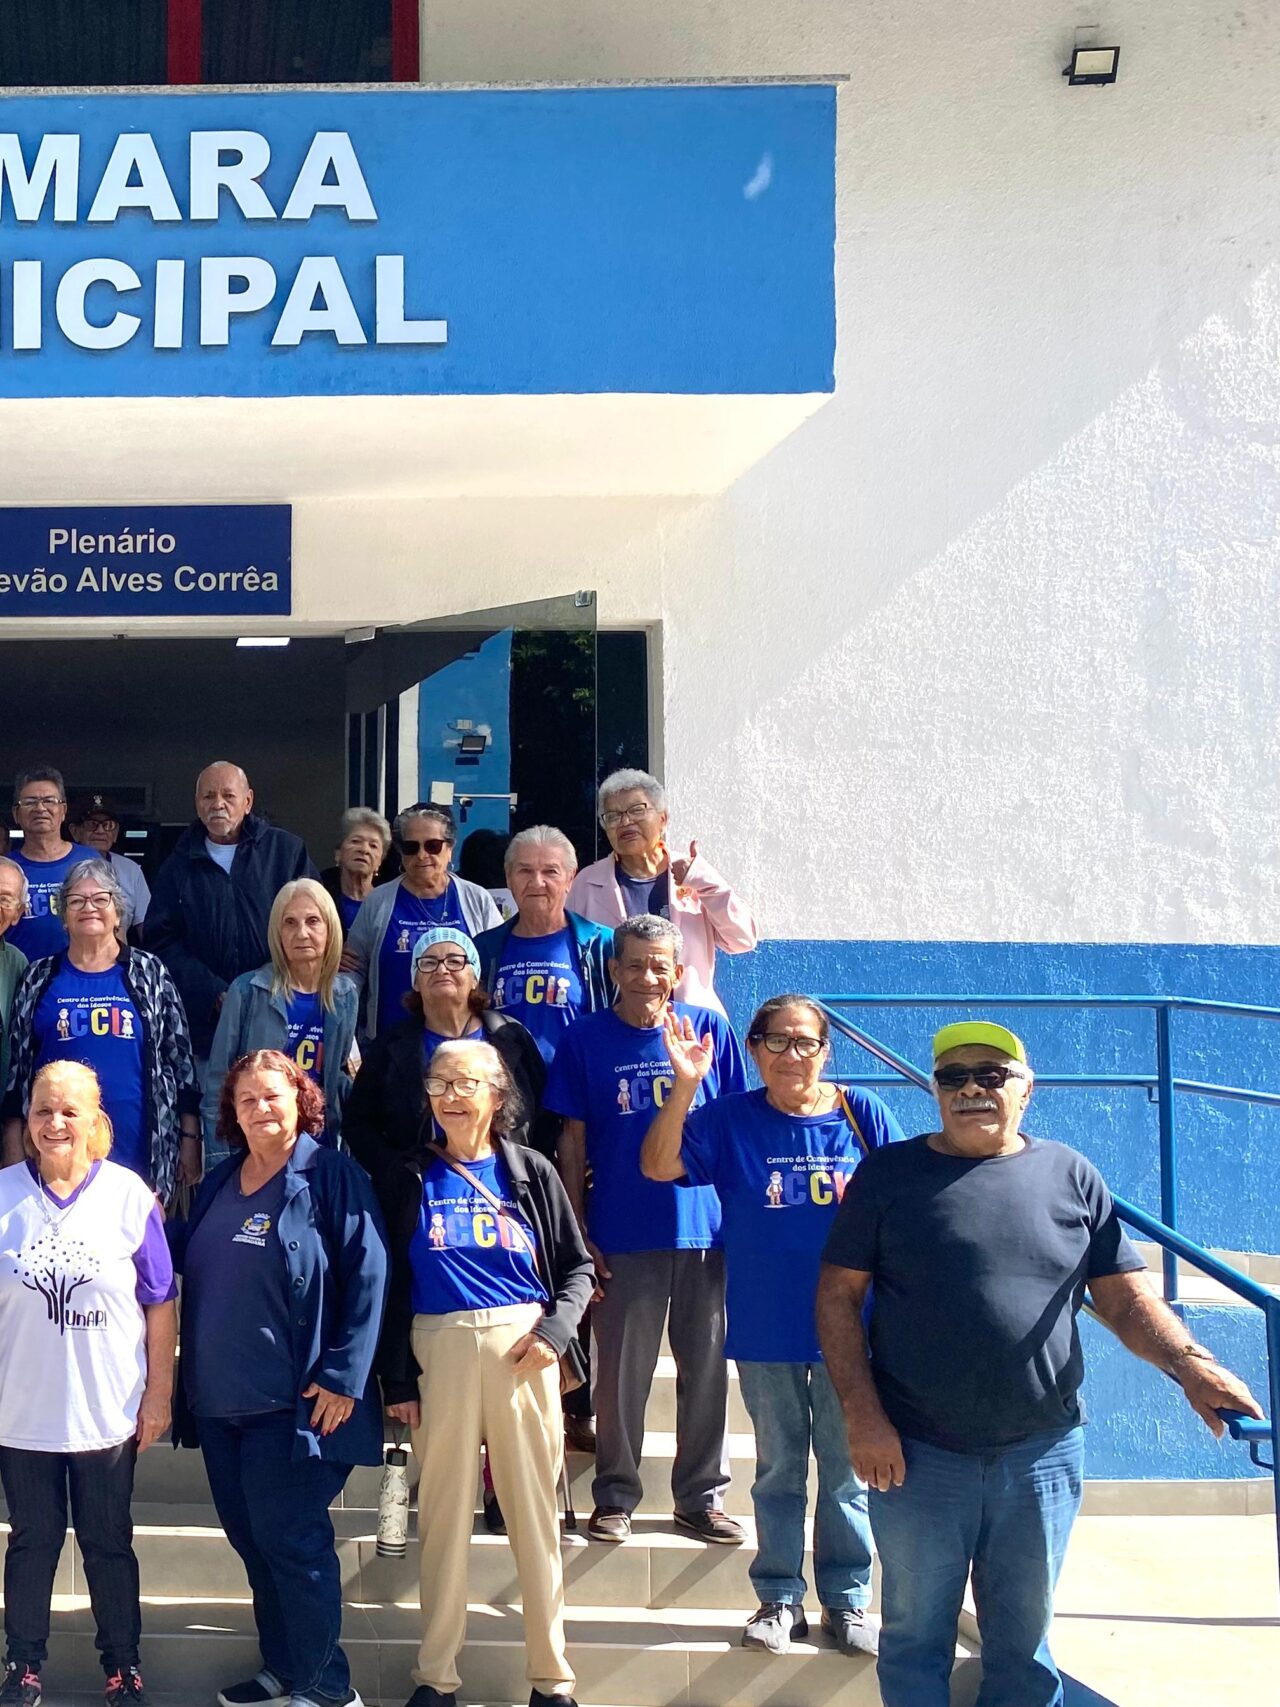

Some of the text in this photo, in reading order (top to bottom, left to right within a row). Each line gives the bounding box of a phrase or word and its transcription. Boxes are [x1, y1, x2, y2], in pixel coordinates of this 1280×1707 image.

[48, 527, 177, 555] Plenário
[75, 566, 164, 593] Alves
[173, 564, 279, 593] Corrêa
[504, 975, 556, 1005] CCI
[70, 1006, 120, 1037] CCI
[614, 1062, 639, 1073] Centro
[639, 1061, 649, 1069] de
[766, 1156, 795, 1164] Centro
[795, 1155, 805, 1163] de
[792, 1164, 807, 1172] dos
[428, 1197, 456, 1207] Centro
[456, 1196, 468, 1205] de
[454, 1205, 470, 1213] dos
[446, 1213, 511, 1248] CCI
[65, 1309, 108, 1327] UnAPI
